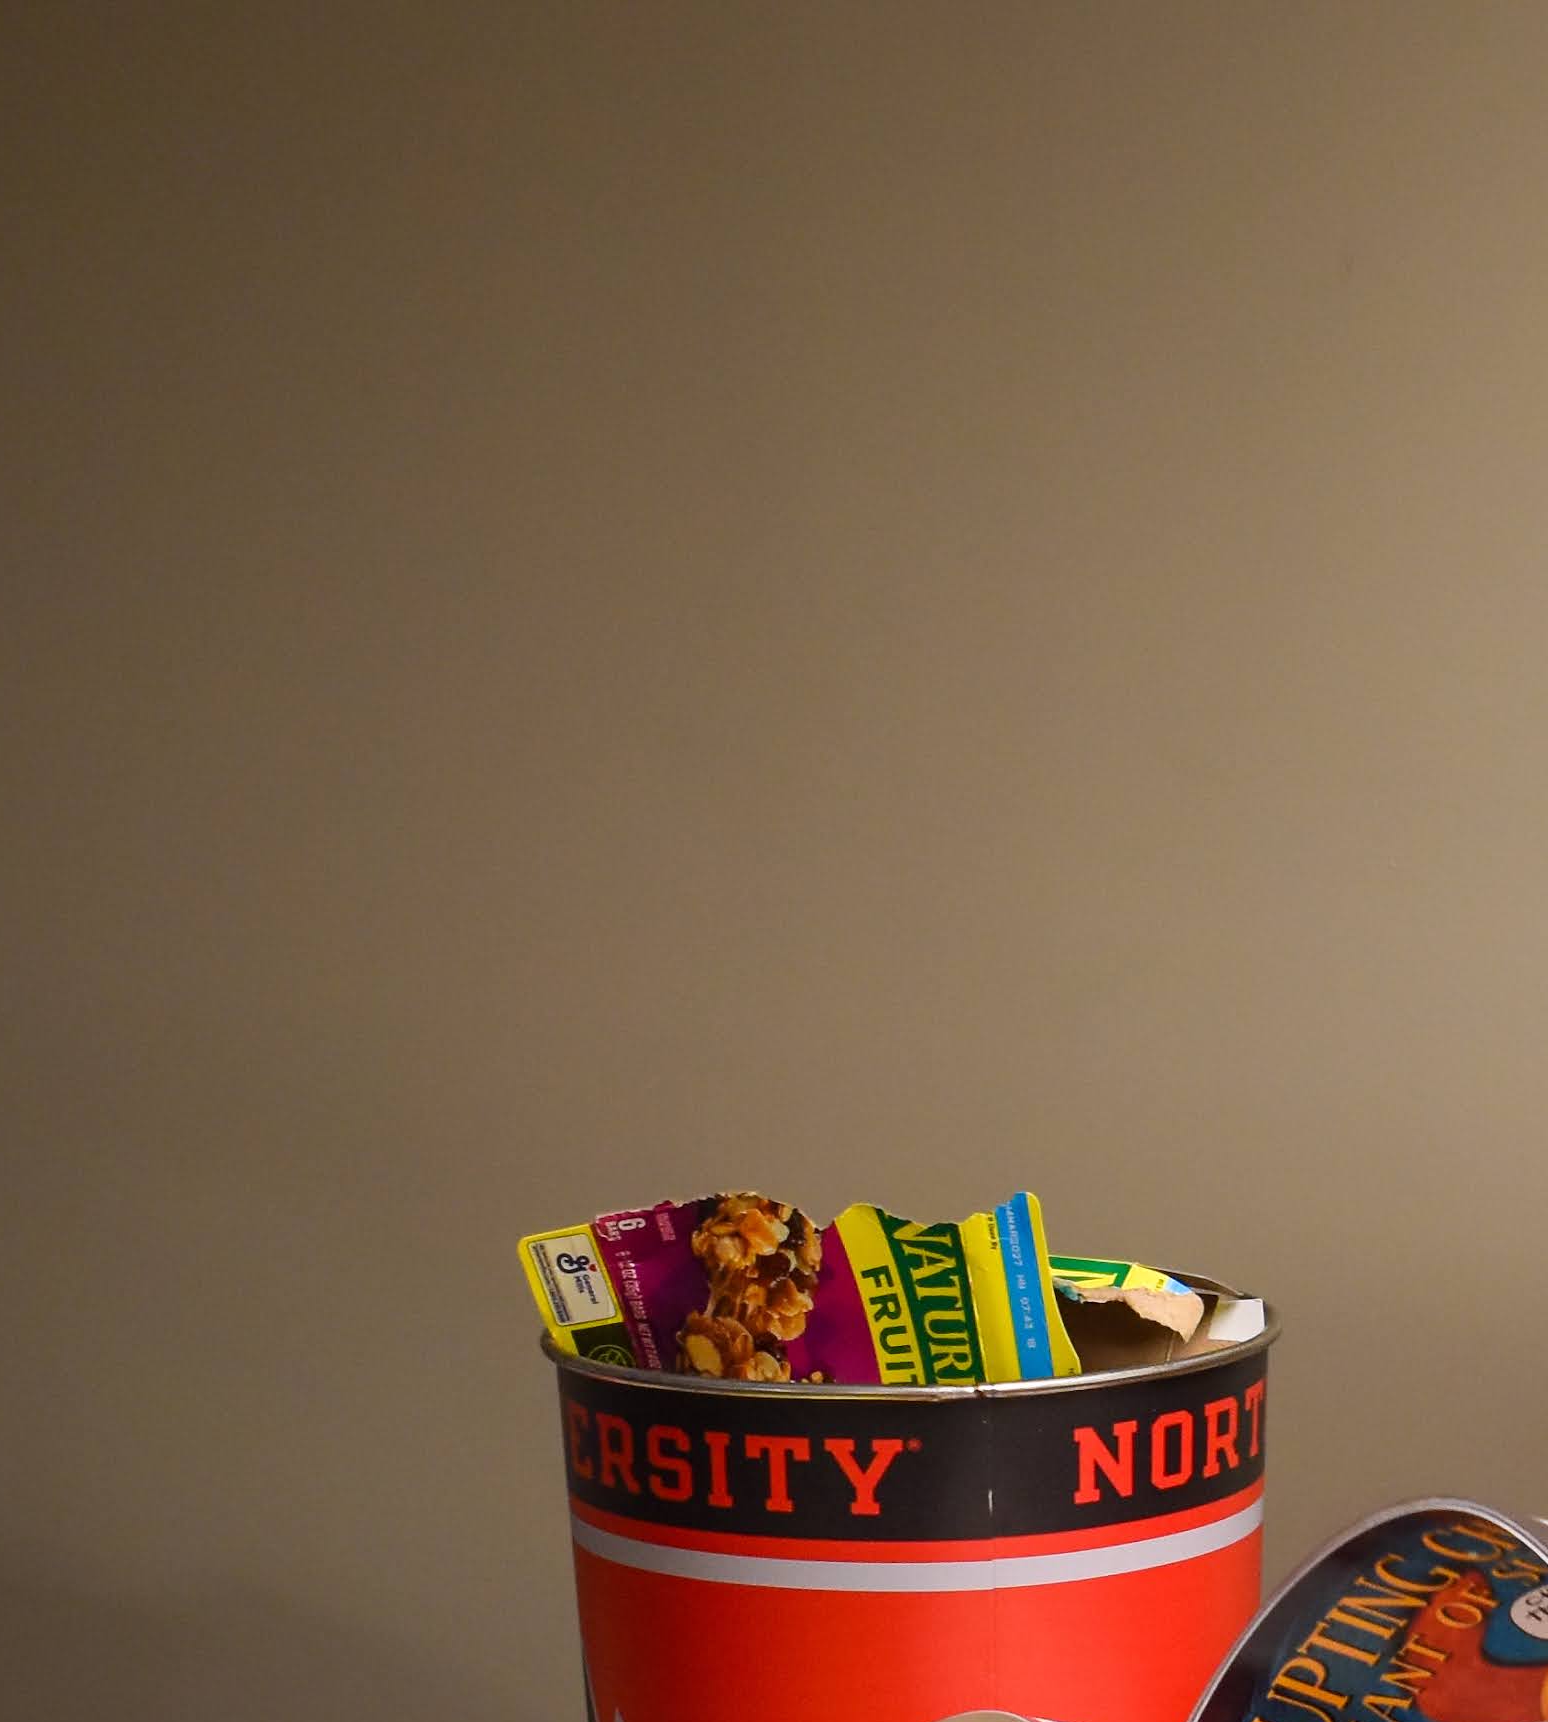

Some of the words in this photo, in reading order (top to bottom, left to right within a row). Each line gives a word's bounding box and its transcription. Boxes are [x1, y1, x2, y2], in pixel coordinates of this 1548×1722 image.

[617, 1217, 646, 1231] 6
[583, 1274, 600, 1304] General
[1435, 1583, 1500, 1629] OF
